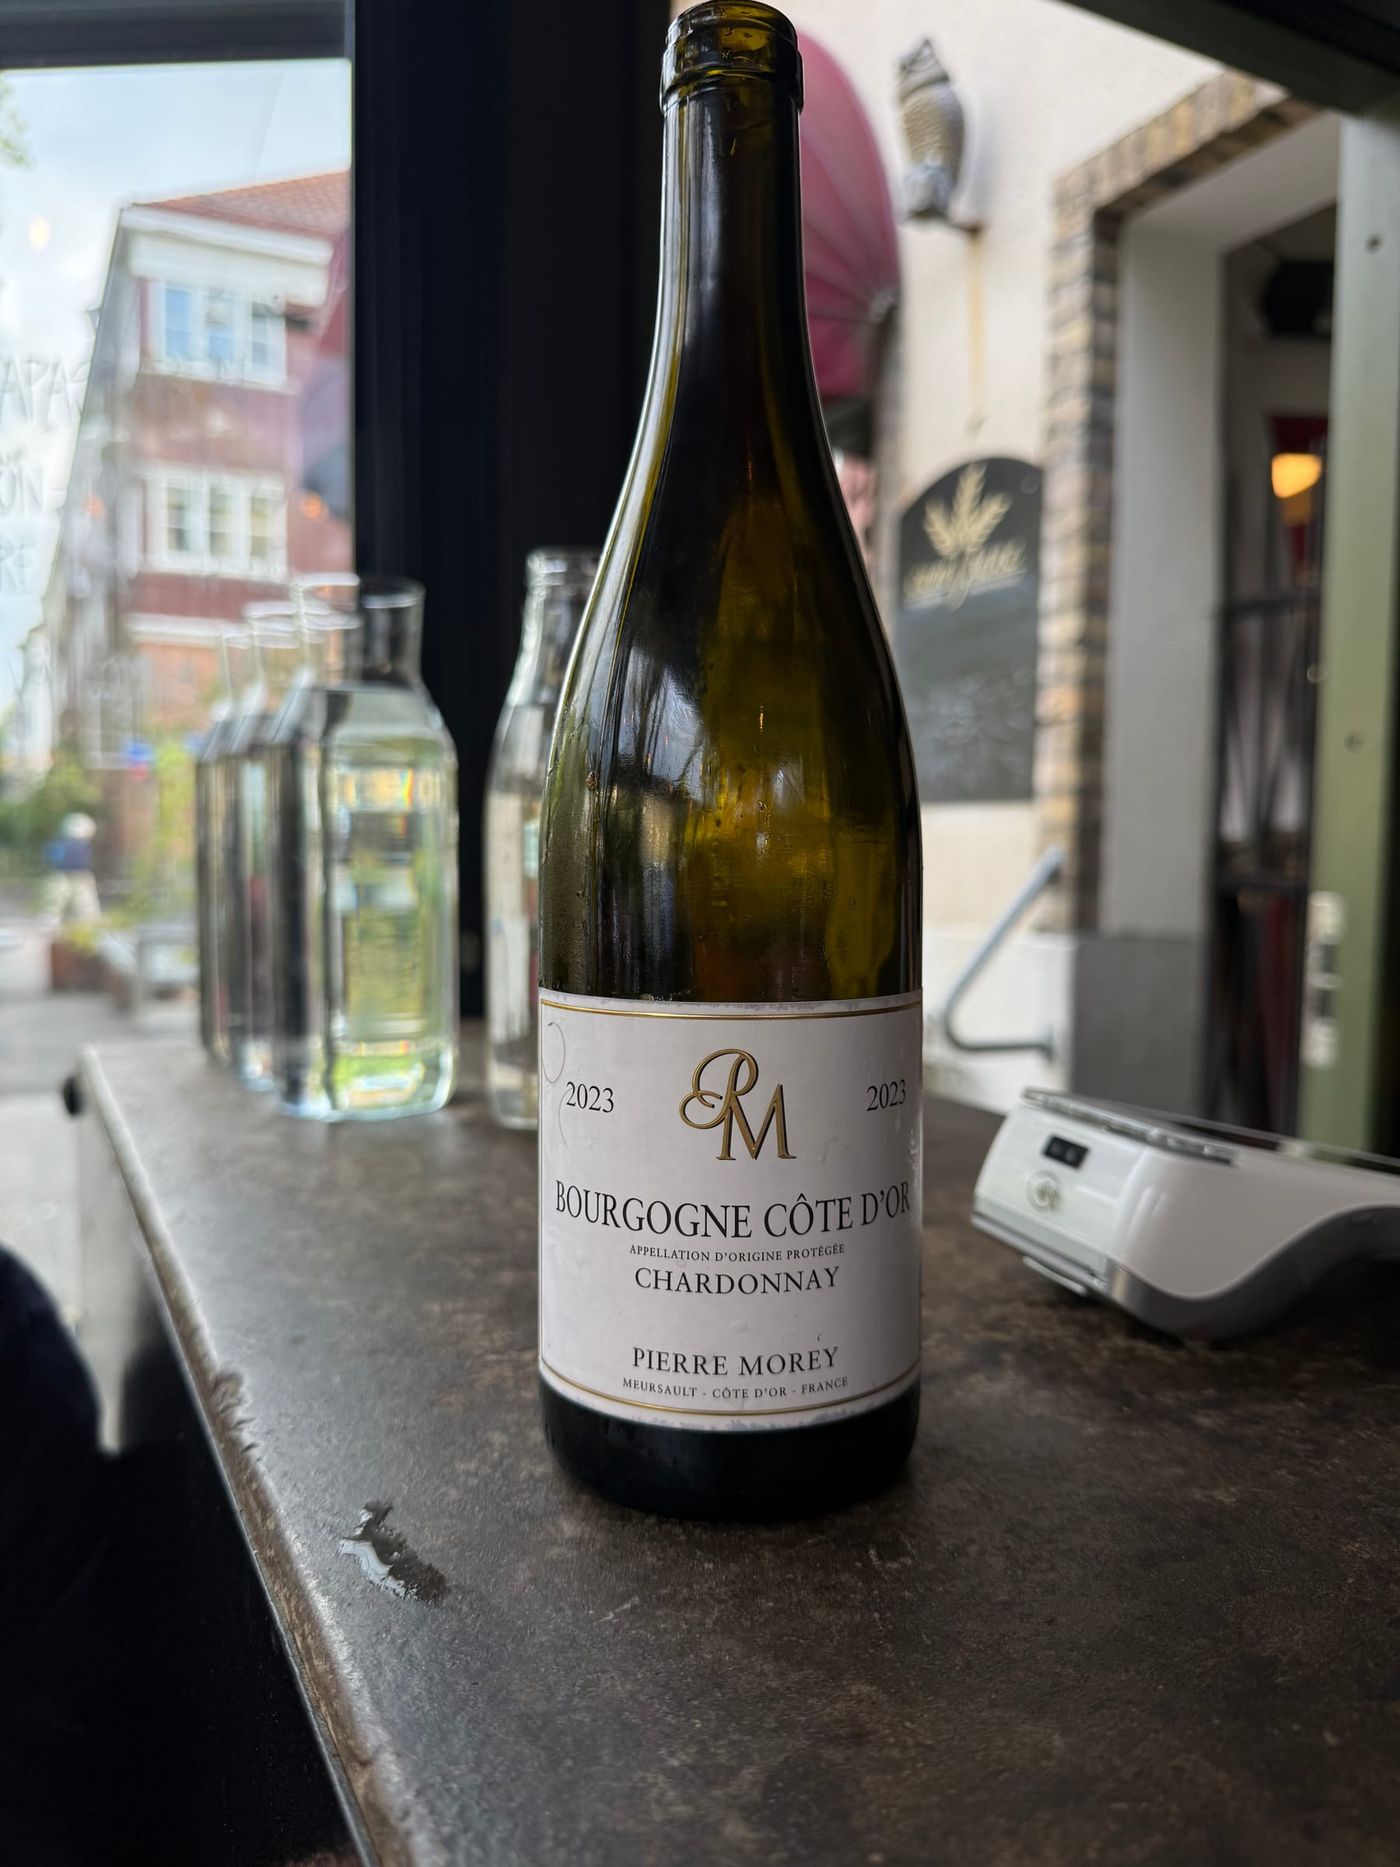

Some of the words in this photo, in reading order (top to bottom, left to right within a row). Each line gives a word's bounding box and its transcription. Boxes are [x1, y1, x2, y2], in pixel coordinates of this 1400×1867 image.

[565, 1080, 615, 1114] 2023
[866, 1078, 907, 1112] 2023
[555, 1179, 753, 1239] BOURGOGNE
[763, 1192, 854, 1237] CÔTE
[860, 1180, 911, 1227] D'OR
[629, 1244, 710, 1262] APPELLATION
[714, 1250, 783, 1263] D'ORIGINE
[786, 1242, 845, 1260] PROTÉGÉE
[634, 1265, 840, 1296] CHARDONNAY
[632, 1346, 729, 1376] PIERRE
[738, 1345, 839, 1377] MOREY
[622, 1377, 698, 1398] MEURSAULT
[712, 1386, 749, 1400] CÔTE
[754, 1386, 787, 1399] D'OR
[801, 1376, 848, 1395] FRANCE
